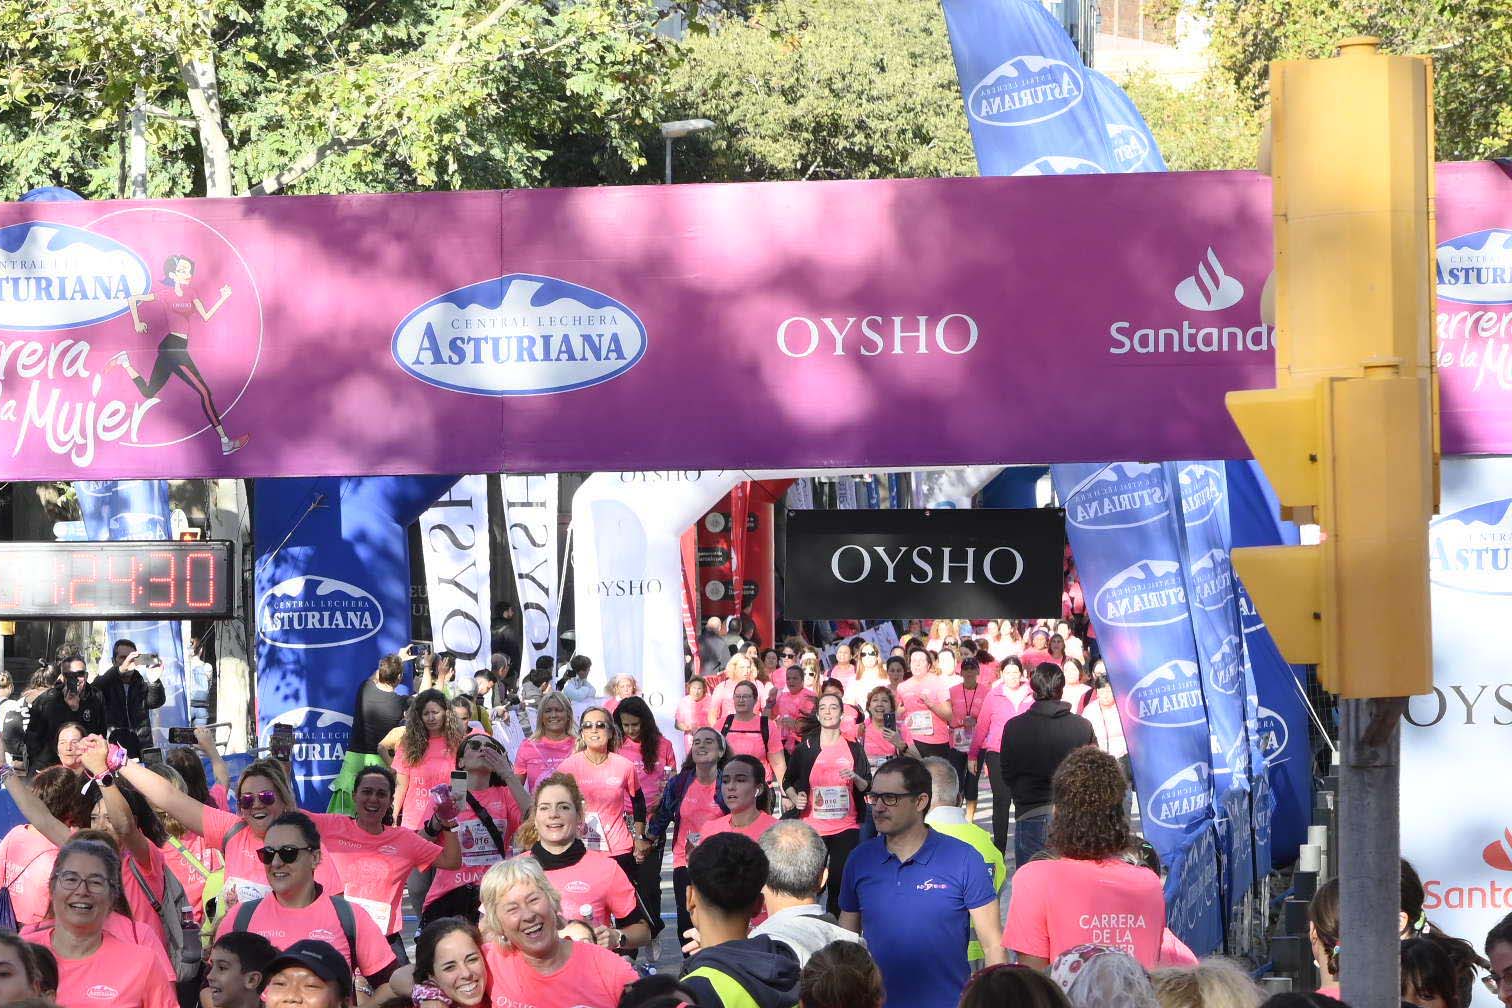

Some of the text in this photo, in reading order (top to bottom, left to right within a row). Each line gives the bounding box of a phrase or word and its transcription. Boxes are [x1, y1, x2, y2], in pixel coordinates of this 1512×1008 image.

[450, 313, 619, 331] CENTRAL LECHERA
[411, 321, 628, 366] ASTURIANA
[775, 312, 980, 359] OYSHO
[1109, 319, 1277, 356] Santand
[10, 373, 162, 468] Mujer
[830, 544, 1025, 586] OYSHO
[273, 599, 369, 610] CENTRAL LECHERA
[262, 603, 374, 633] ASTURIANA
[295, 731, 349, 741] TRAL LECH
[455, 871, 482, 884] SUM
[1078, 913, 1146, 929] CARRERA
[1092, 929, 1133, 943] DE LA
